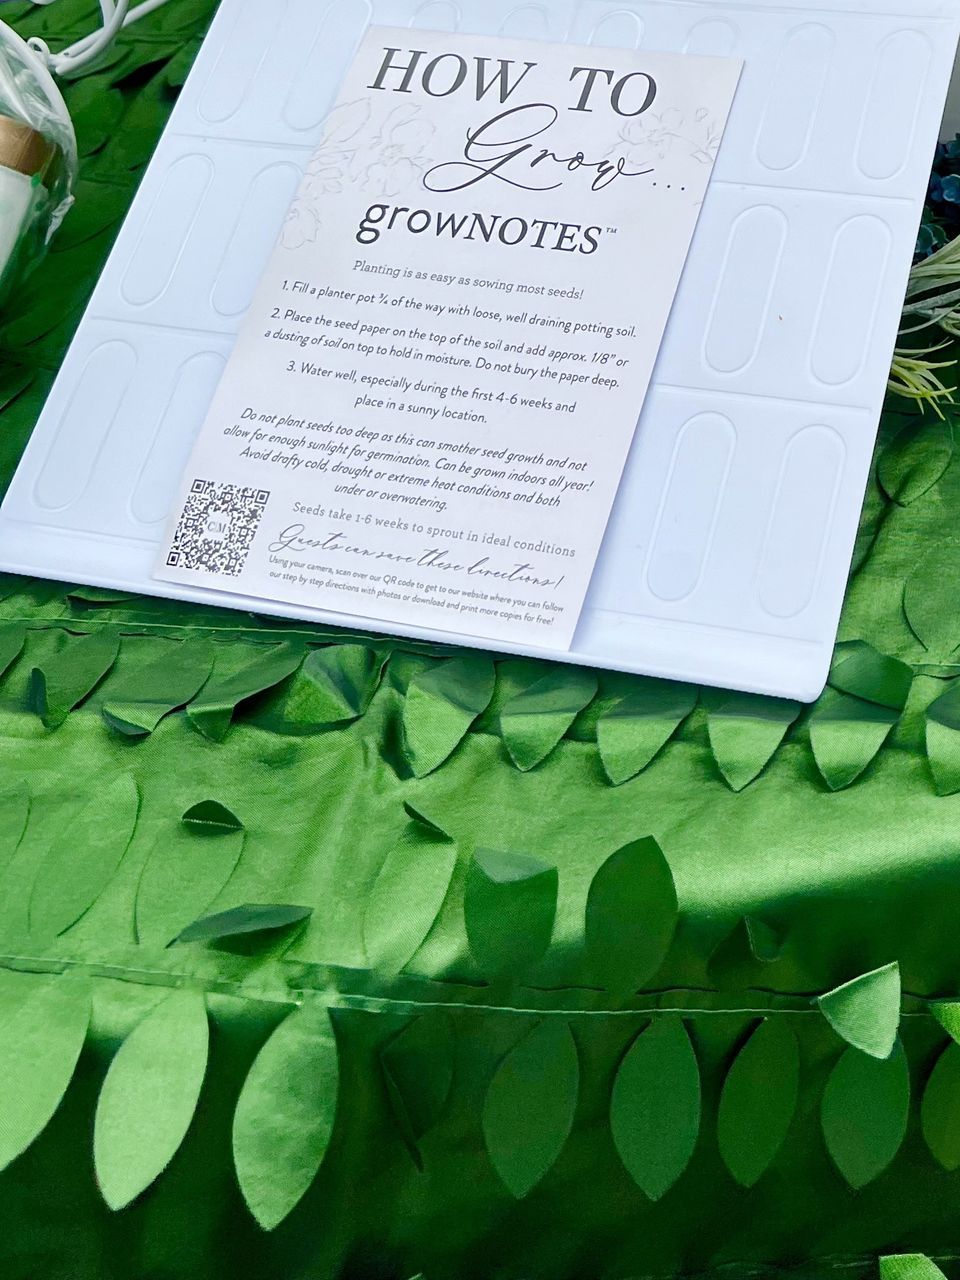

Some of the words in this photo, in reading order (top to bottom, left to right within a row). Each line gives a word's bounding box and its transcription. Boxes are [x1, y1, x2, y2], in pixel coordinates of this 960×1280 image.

[366, 47, 537, 103] HOW
[567, 66, 657, 117] TO
[352, 260, 401, 279] Planting
[402, 267, 413, 278] is
[415, 271, 428, 280] as
[430, 273, 457, 286] easy
[457, 277, 471, 286] as
[472, 279, 514, 293] sowing
[516, 284, 545, 295] most
[547, 287, 584, 300] seeds!
[270, 307, 280, 319] 2.
[284, 309, 313, 324] Place
[314, 314, 332, 327] the
[334, 320, 360, 330] seed
[358, 324, 391, 337] paper
[392, 329, 406, 337] on
[408, 327, 427, 340] the
[429, 332, 447, 346] top
[449, 333, 464, 344] of
[463, 335, 482, 348] the
[483, 339, 503, 350] soil
[503, 342, 525, 353] and
[525, 344, 547, 356] add
[548, 350, 587, 362] approx.
[615, 359, 629, 367] or
[282, 280, 288, 291] 1.
[292, 281, 310, 293] Fill
[309, 287, 316, 295] a
[316, 286, 356, 300] planter
[355, 294, 376, 304] pot
[391, 296, 405, 306] of
[405, 297, 423, 310] the
[425, 303, 446, 316] way
[448, 304, 470, 316] with
[472, 306, 502, 322] loose,
[506, 312, 528, 323] well
[528, 314, 572, 333] draining
[572, 322, 614, 339] potting
[616, 326, 636, 338] soil.
[264, 330, 272, 338] a
[272, 328, 310, 347] dusting
[310, 334, 326, 345] of
[323, 337, 344, 348] soil
[341, 342, 355, 350] on
[357, 343, 374, 357] top
[376, 345, 388, 355] to
[389, 344, 413, 359] hold
[413, 349, 423, 360] in
[424, 352, 472, 368] moisture.
[475, 356, 492, 370] Do
[493, 363, 512, 373] not
[513, 362, 539, 380] bury
[540, 366, 558, 379] the
[558, 372, 590, 385] paper
[591, 373, 619, 390] deep.
[286, 360, 296, 372] 3.
[301, 362, 333, 377] Water
[335, 369, 357, 384] well,
[360, 375, 412, 393] especially
[413, 380, 448, 399] during
[450, 385, 469, 398] the
[471, 387, 494, 402] first
[495, 392, 518, 405] 4-6
[520, 397, 553, 410] weeks
[555, 401, 577, 413] and
[354, 394, 384, 408] place
[385, 397, 396, 410] in
[398, 403, 405, 411] a
[407, 404, 440, 420] sunny
[441, 406, 487, 423] location.
[223, 425, 251, 438] allow
[248, 428, 268, 443] for
[268, 435, 306, 450] enough
[306, 440, 349, 456] sunlight
[346, 444, 367, 459] for
[364, 451, 430, 468] germination.
[435, 457, 457, 471] Can
[458, 461, 472, 474] be
[470, 467, 506, 479] grown
[507, 469, 547, 485] indoors
[548, 475, 565, 487] all
[560, 480, 595, 492] year!
[240, 407, 257, 420] Do
[258, 414, 277, 424] not
[274, 414, 306, 428] plant
[306, 421, 334, 433] seeds
[335, 425, 353, 436] too
[354, 426, 380, 443] deep
[381, 434, 393, 442] as
[394, 432, 415, 446] this
[416, 439, 436, 448] can
[436, 442, 481, 455] smother
[481, 448, 509, 459] seed
[504, 453, 544, 465] growth
[545, 457, 570, 468] and
[567, 462, 588, 471] not
[239, 446, 274, 461] Avoid
[271, 451, 304, 470] drafty
[304, 458, 330, 473] cold,
[331, 461, 373, 479] drought
[374, 471, 387, 479] or
[387, 473, 430, 487] extreme
[430, 476, 456, 491] heat
[457, 484, 512, 500] conditions
[513, 491, 537, 503] and
[534, 492, 561, 507] both
[334, 483, 366, 496] under
[365, 490, 379, 498] or
[379, 492, 447, 513] overwatering.
[292, 501, 325, 517] Seeds
[328, 508, 352, 521] take
[355, 514, 373, 524] 1-6
[375, 517, 409, 530] weeks
[412, 523, 424, 533] to
[426, 527, 464, 540] sprout
[466, 530, 478, 542] in
[481, 532, 512, 547] ideal
[513, 540, 576, 558] conditions
[269, 554, 289, 569] Using
[288, 561, 306, 569] your
[306, 564, 334, 575] camera,
[369, 574, 382, 582] our
[383, 574, 397, 585] QR
[397, 579, 415, 588] code
[424, 584, 438, 593] get
[438, 585, 447, 593] to
[461, 589, 489, 600] website
[489, 593, 512, 604] where
[511, 599, 527, 608] you
[527, 601, 541, 609] can
[542, 600, 564, 612] follow
[282, 573, 298, 584] step
[298, 574, 308, 586] by
[309, 578, 324, 589] step
[325, 579, 360, 593] directions
[360, 587, 376, 595] with
[376, 589, 401, 600] photos
[411, 594, 446, 607] download
[446, 601, 461, 610] and
[459, 605, 479, 614] print
[479, 608, 499, 616] more
[499, 611, 522, 621] copies
[523, 612, 535, 622] for
[536, 614, 555, 625] free!
